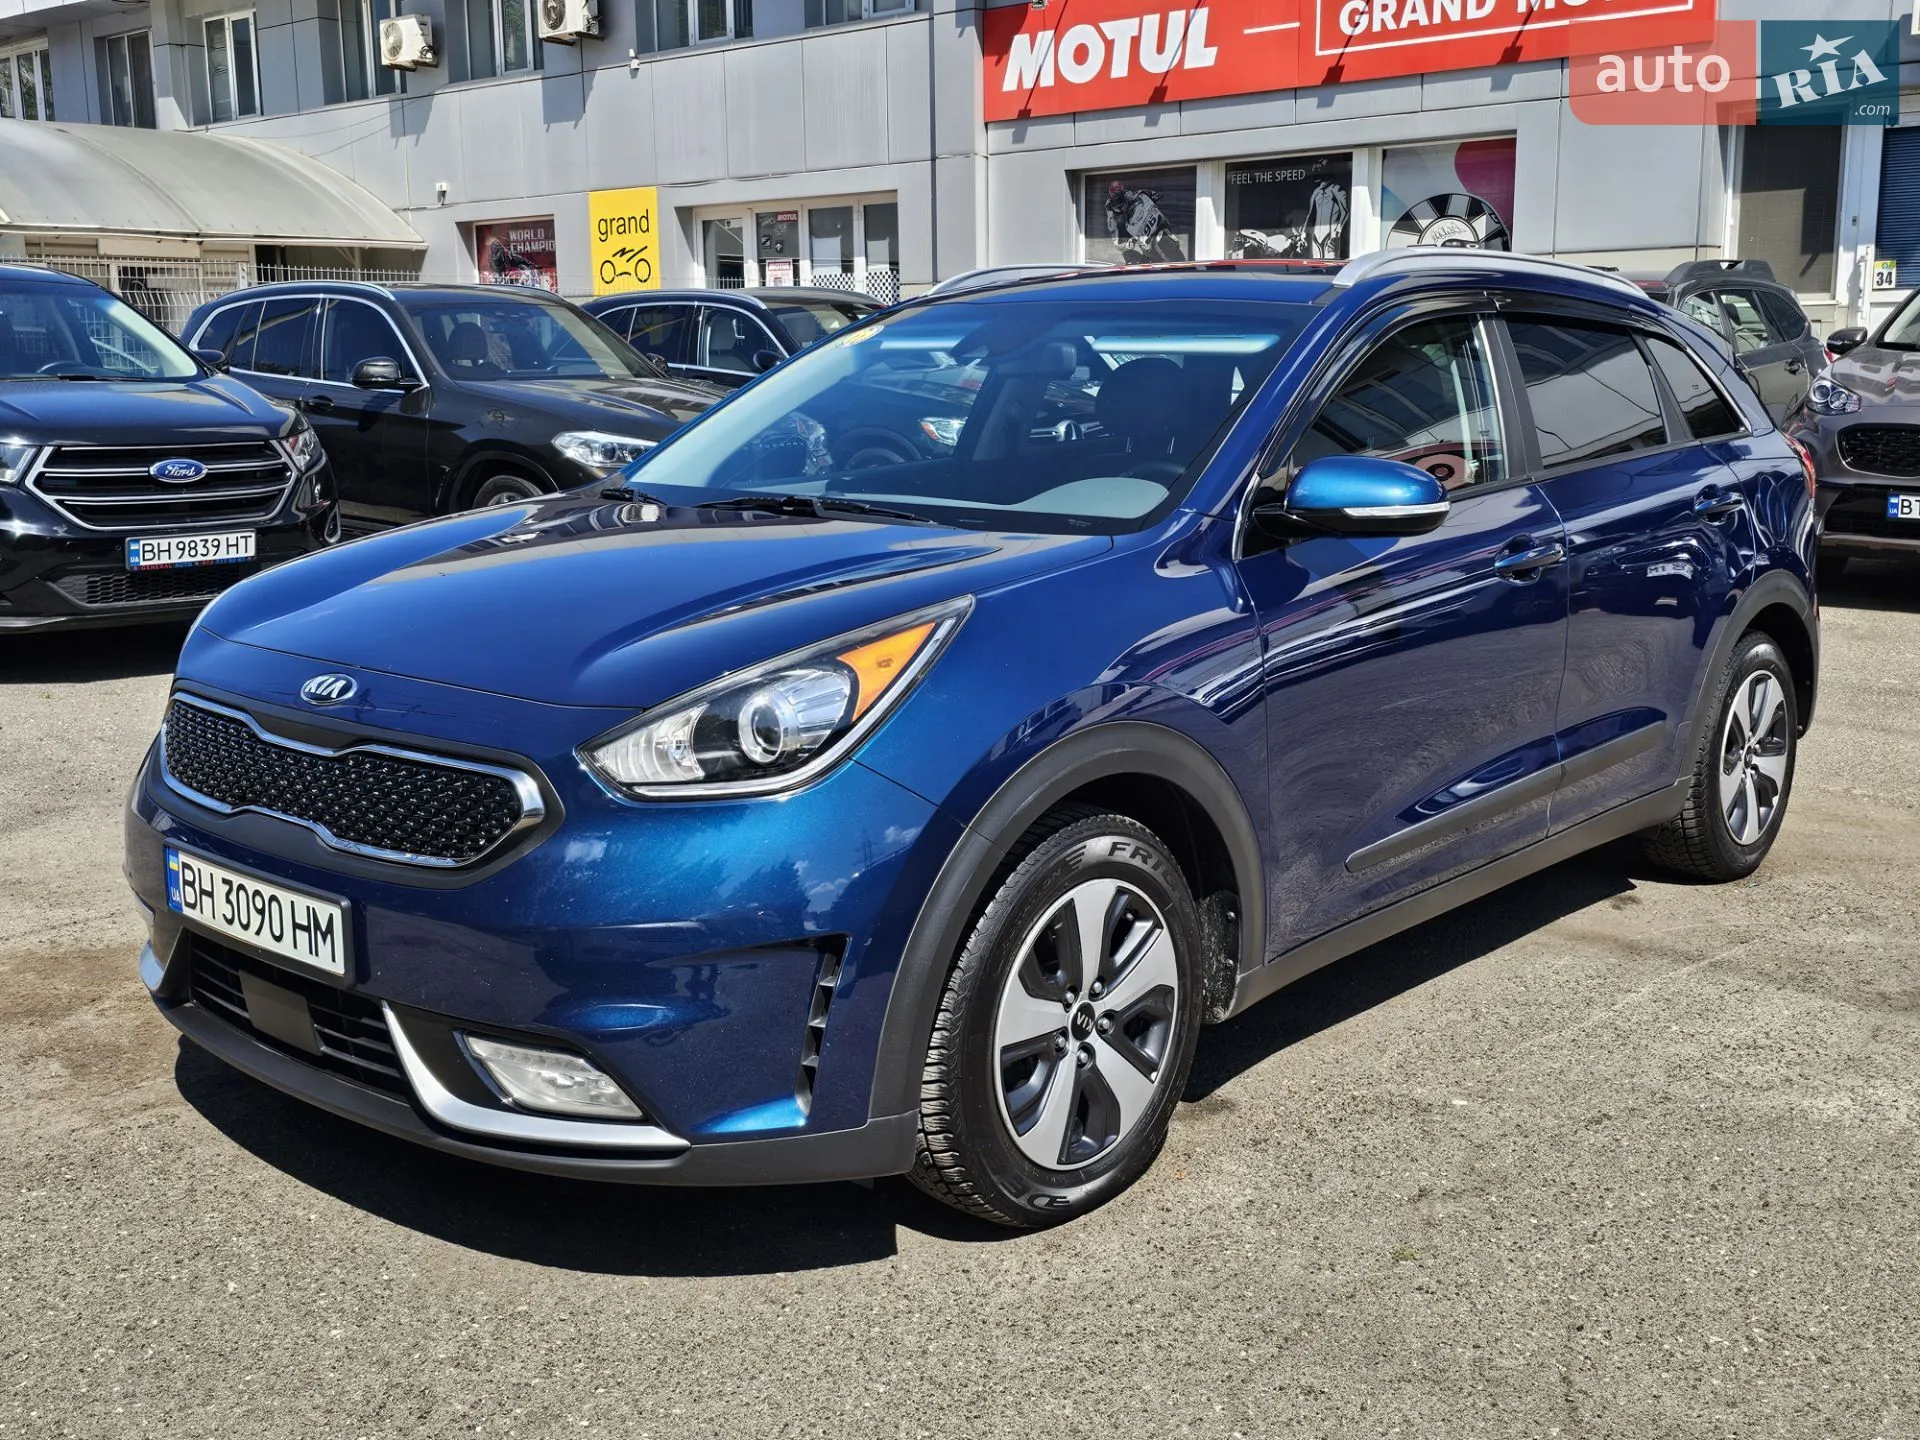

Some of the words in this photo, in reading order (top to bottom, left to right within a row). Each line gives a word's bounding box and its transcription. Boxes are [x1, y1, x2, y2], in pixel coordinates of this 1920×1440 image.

[1339, 0, 1498, 36] GRAND
[1002, 7, 1219, 92] MOTUL
[1231, 173, 1253, 185] FEEL
[1254, 171, 1273, 183] THE
[1275, 169, 1306, 182] SPEED
[597, 208, 650, 243] grand
[776, 213, 798, 222] MOTUL
[509, 228, 545, 242] WORLD
[1876, 271, 1893, 287] 34
[165, 464, 196, 476] Ford
[142, 542, 172, 562] BH
[175, 538, 221, 560] 9839
[226, 534, 253, 555] HT
[130, 555, 140, 563] UA
[304, 676, 348, 699] KIA
[170, 886, 182, 904] UA
[181, 861, 217, 920] BH
[221, 877, 285, 944] 3090
[290, 899, 337, 964] HM
